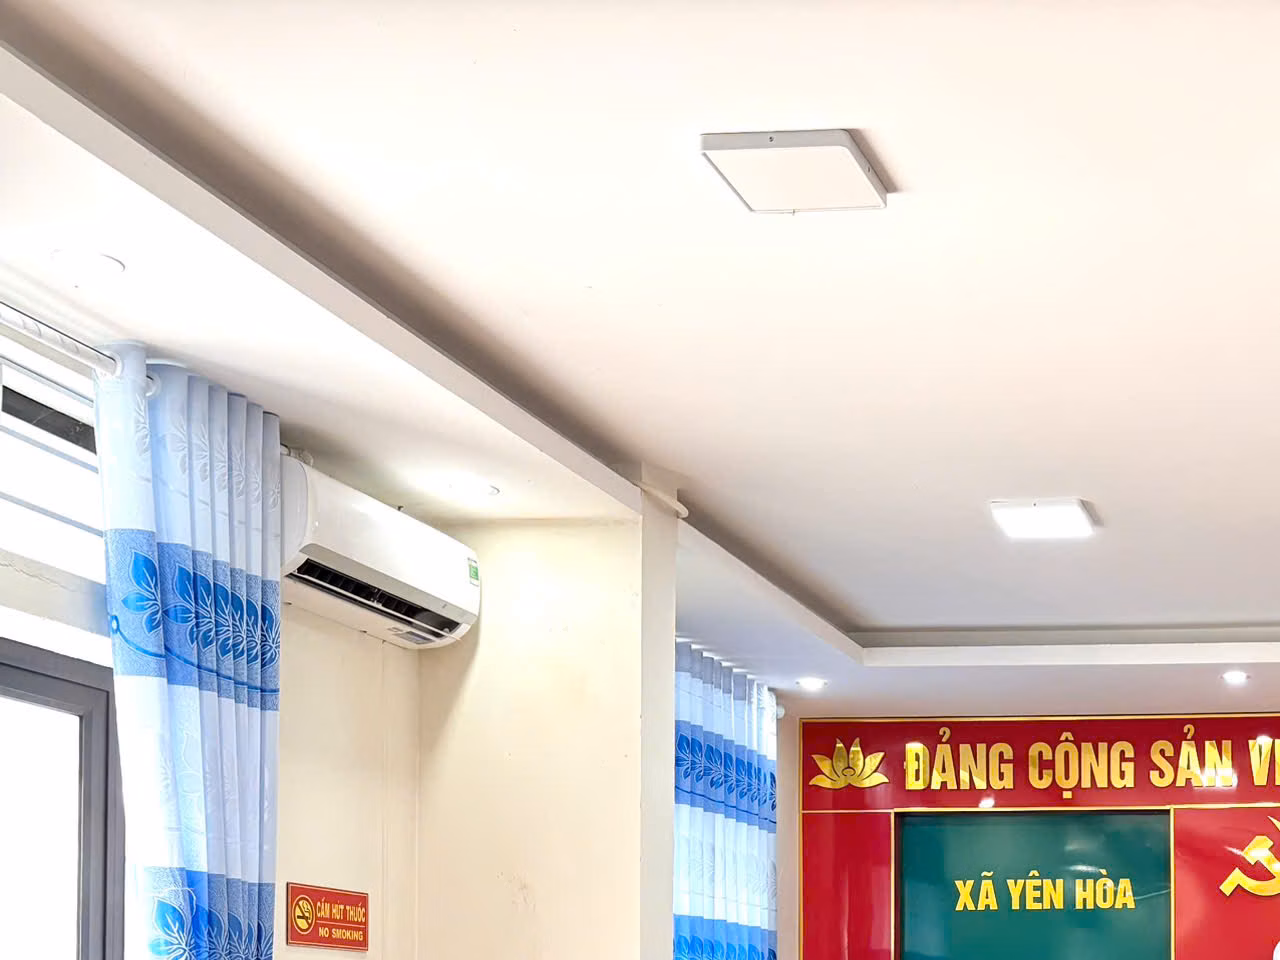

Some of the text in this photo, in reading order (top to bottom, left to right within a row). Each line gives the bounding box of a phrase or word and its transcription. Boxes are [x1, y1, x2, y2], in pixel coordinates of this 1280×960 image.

[904, 727, 1014, 790] ĐẢNG
[1028, 731, 1135, 799] CỘNG
[1149, 724, 1234, 788] SẢN
[954, 868, 1136, 911] XÃ YÊN HÒA
[316, 897, 366, 922] CẤM HÚT THUỐC
[318, 927, 364, 941] NO SMOKING
